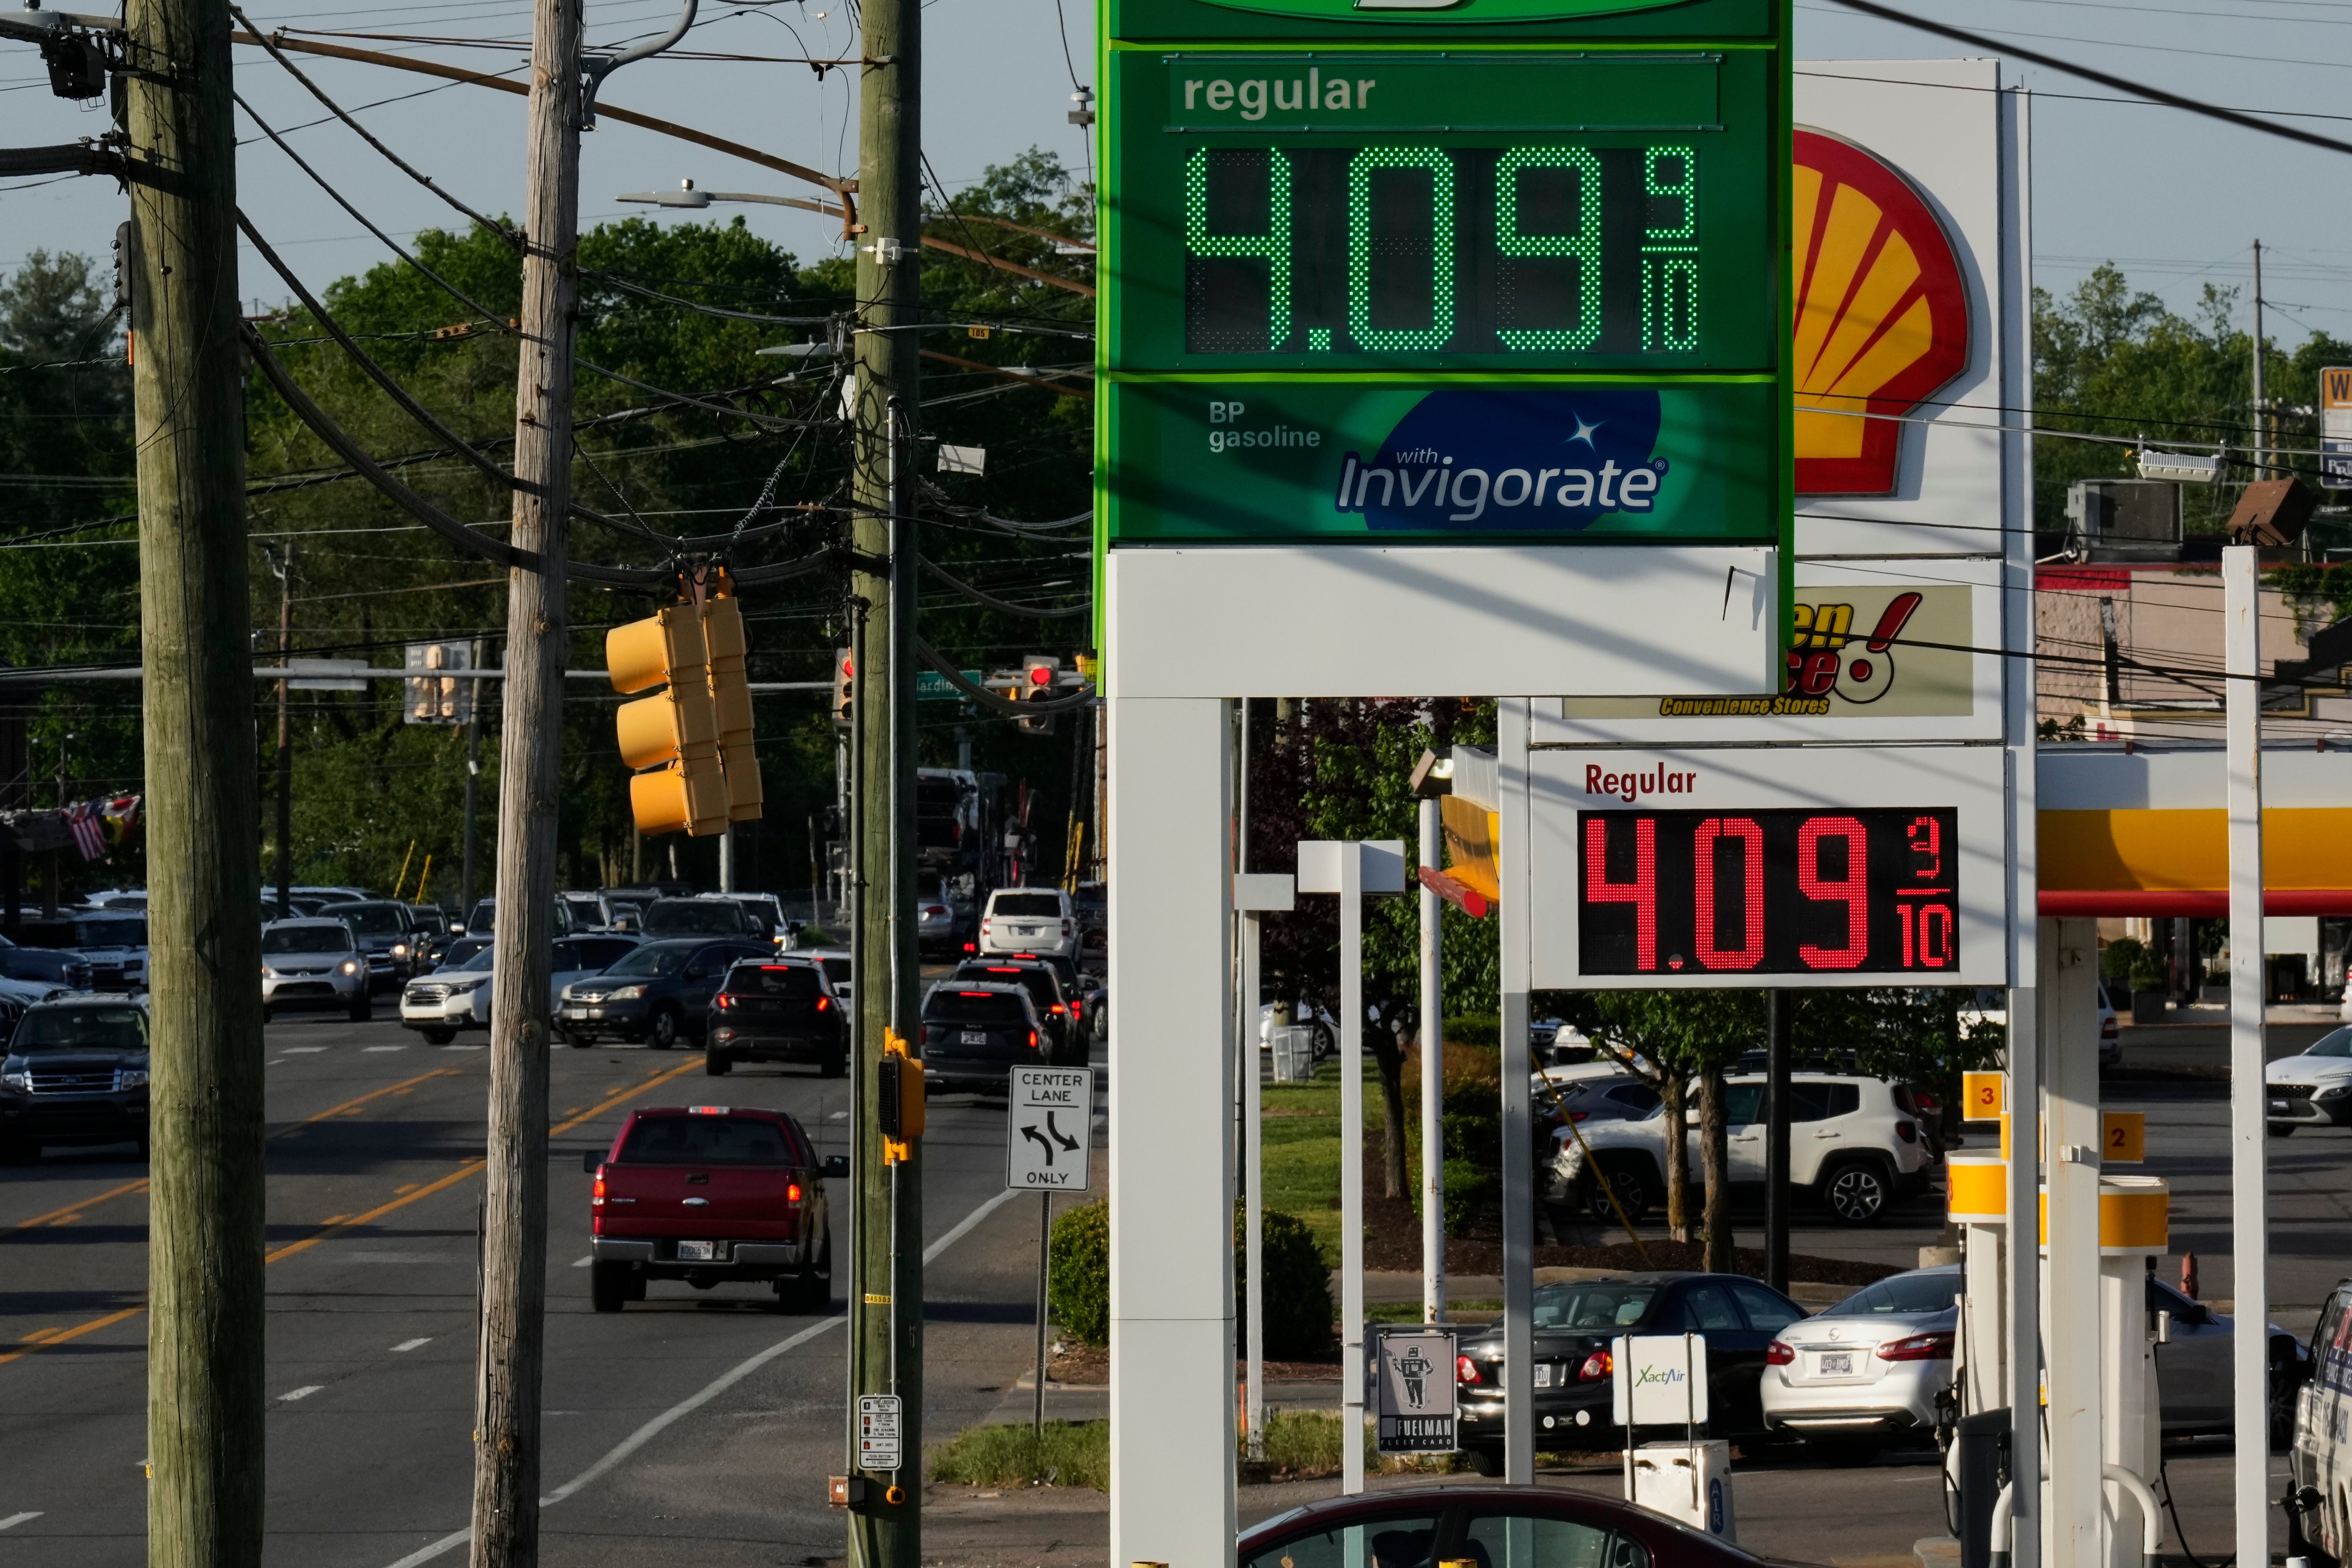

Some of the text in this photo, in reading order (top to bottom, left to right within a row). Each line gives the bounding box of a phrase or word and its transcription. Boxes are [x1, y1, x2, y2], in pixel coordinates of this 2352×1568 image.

[1185, 67, 1375, 121] regular
[1186, 147, 1602, 352] 4.09
[972, 329, 985, 337] 105
[1210, 402, 1245, 423] BP
[1209, 425, 1321, 453] gasoline
[1396, 447, 1438, 464] with
[1661, 696, 1829, 715] Convenience Stores
[1586, 762, 1697, 803] Regular
[1586, 817, 1868, 970] 4.09
[1022, 1073, 1083, 1086] CENTER
[1031, 1089, 1071, 1102] LANE
[1981, 1087, 1995, 1105] 3
[2111, 1128, 2125, 1147] 2
[1026, 1172, 1069, 1184] ONLY
[1635, 1364, 1685, 1387] XactAir
[1398, 1419, 1451, 1436] FUELMAN
[1712, 1483, 1721, 1526] AIR
